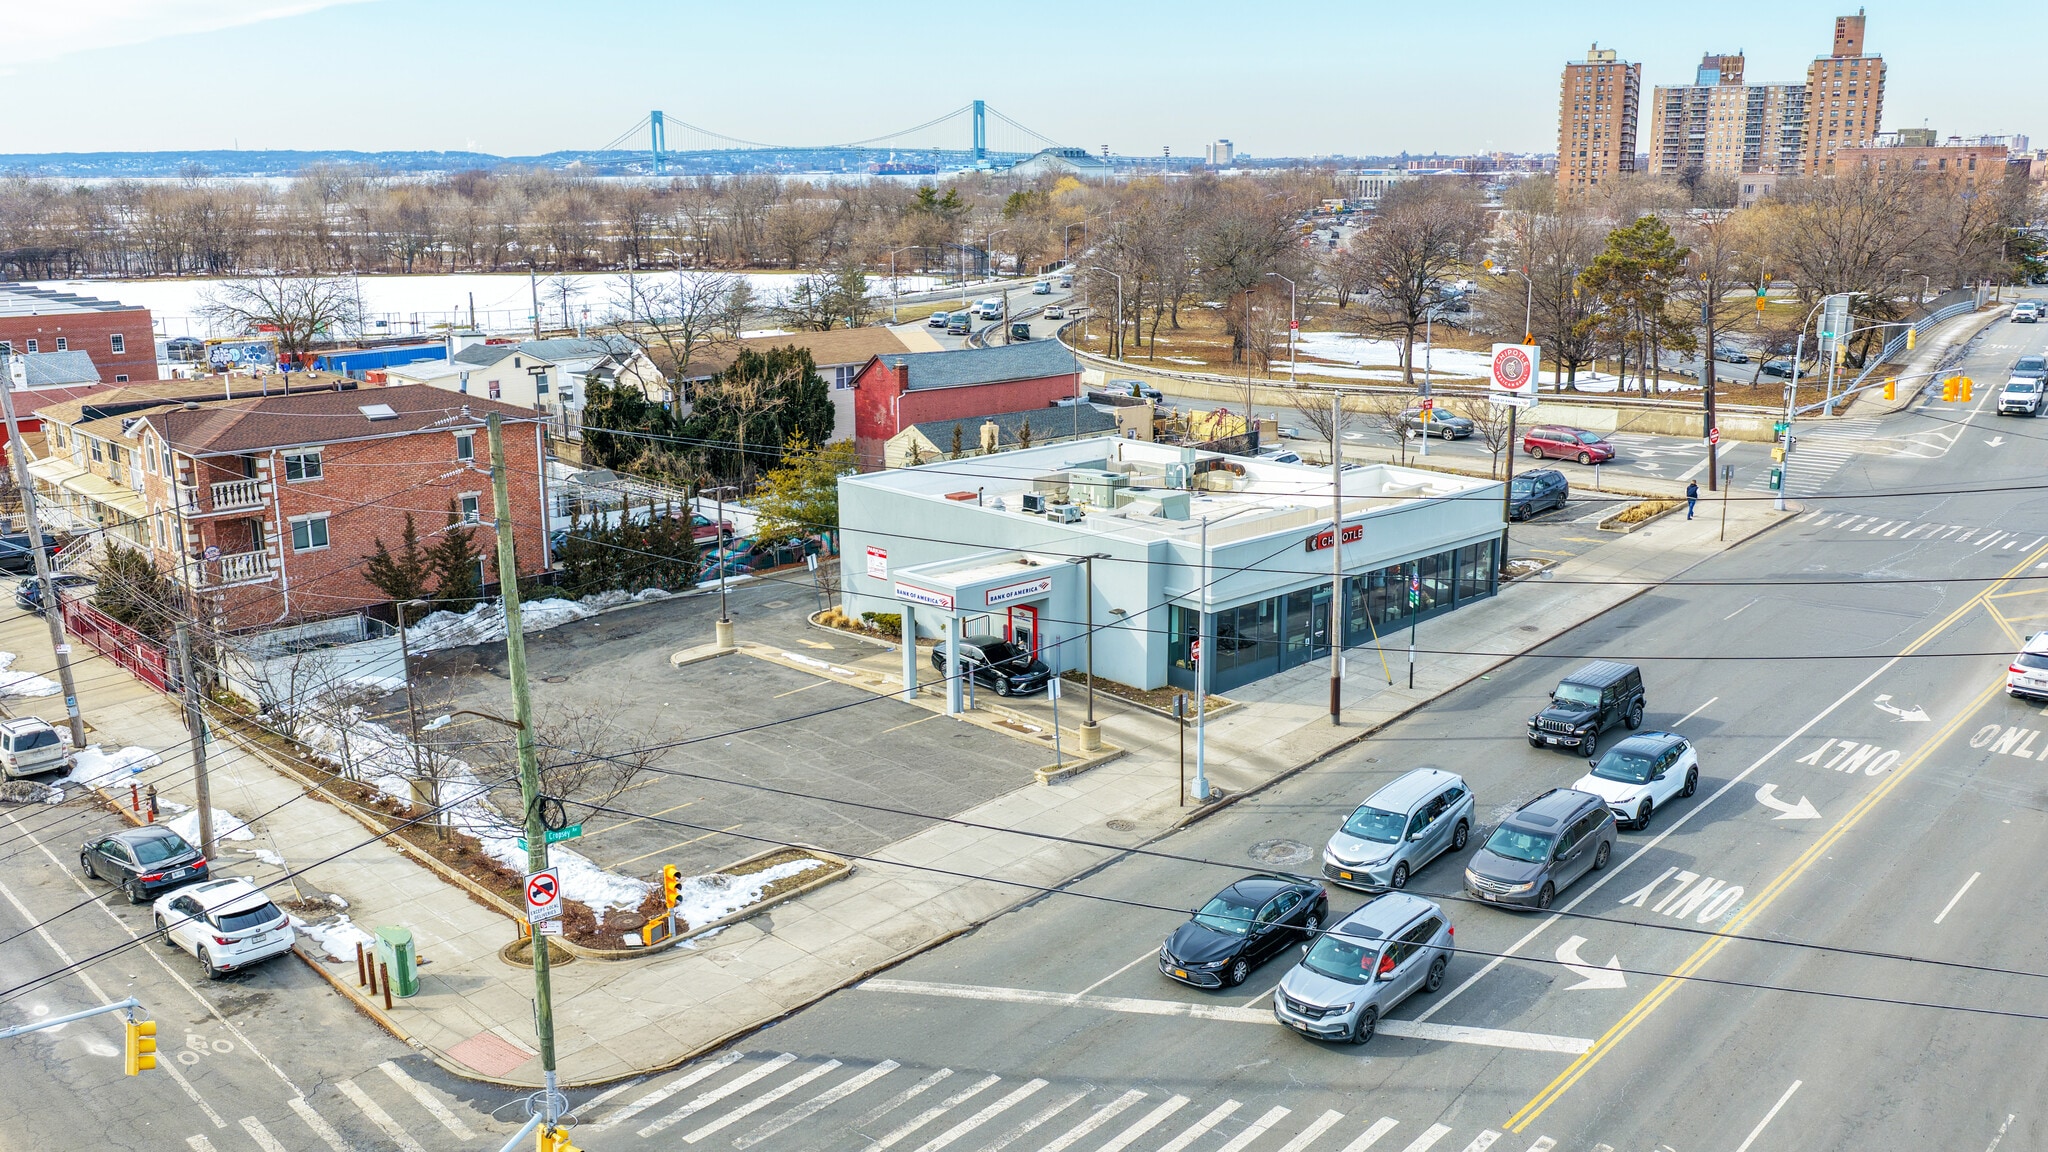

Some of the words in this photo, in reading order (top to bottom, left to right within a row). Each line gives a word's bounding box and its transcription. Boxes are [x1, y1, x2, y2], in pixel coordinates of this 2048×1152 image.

[1495, 350, 1529, 366] CHIPOTLE
[1496, 371, 1515, 387] MEXICAN
[1515, 374, 1528, 386] GRILL
[1321, 529, 1363, 547] CHOTLE
[896, 588, 910, 597] BANK
[917, 594, 939, 604] AMERICA
[990, 593, 1005, 602] BANK
[1014, 586, 1038, 597] AMERICA
[1796, 738, 1901, 776] ONLY
[548, 830, 571, 840] Cropsey
[1618, 866, 1745, 924] ONLY
[530, 907, 546, 916] EXCEPT
[534, 910, 557, 920] DELIVERIES
